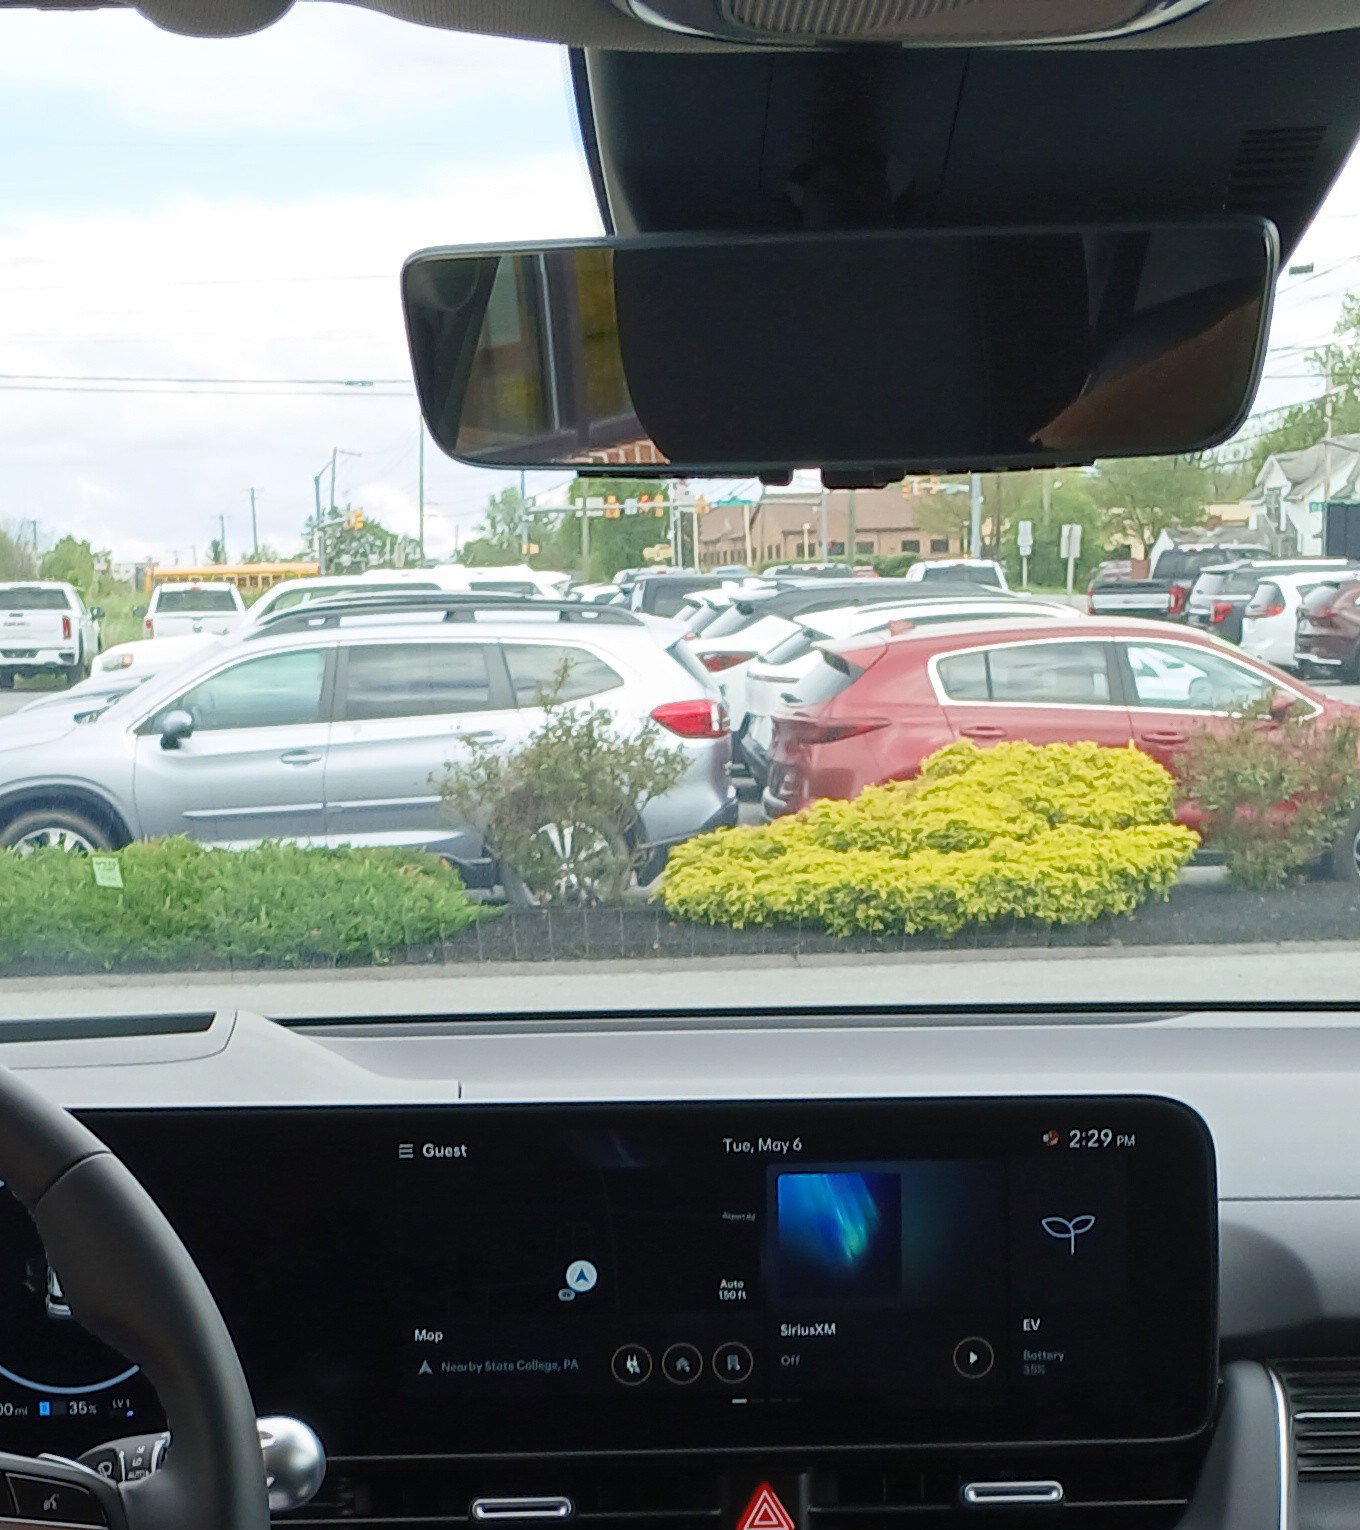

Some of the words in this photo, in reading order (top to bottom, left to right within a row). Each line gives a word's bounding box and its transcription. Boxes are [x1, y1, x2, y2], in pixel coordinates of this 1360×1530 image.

[722, 1136, 756, 1156] Tue,
[758, 1136, 788, 1156] May
[790, 1136, 802, 1152] 6
[1068, 1128, 1114, 1148] 2:29
[1116, 1134, 1136, 1148] PM
[422, 1142, 468, 1160] Guest
[720, 1278, 745, 1290] Auto
[737, 1290, 747, 1300] ft
[780, 1322, 836, 1338] SiriusXM
[1022, 1317, 1041, 1332] EV
[414, 1328, 444, 1344] Map
[780, 1354, 800, 1366] Off
[1022, 1349, 1066, 1362] Battery
[440, 1360, 483, 1374] Nearby
[484, 1360, 515, 1373] State
[516, 1358, 562, 1374] College,
[563, 1358, 579, 1371] PA
